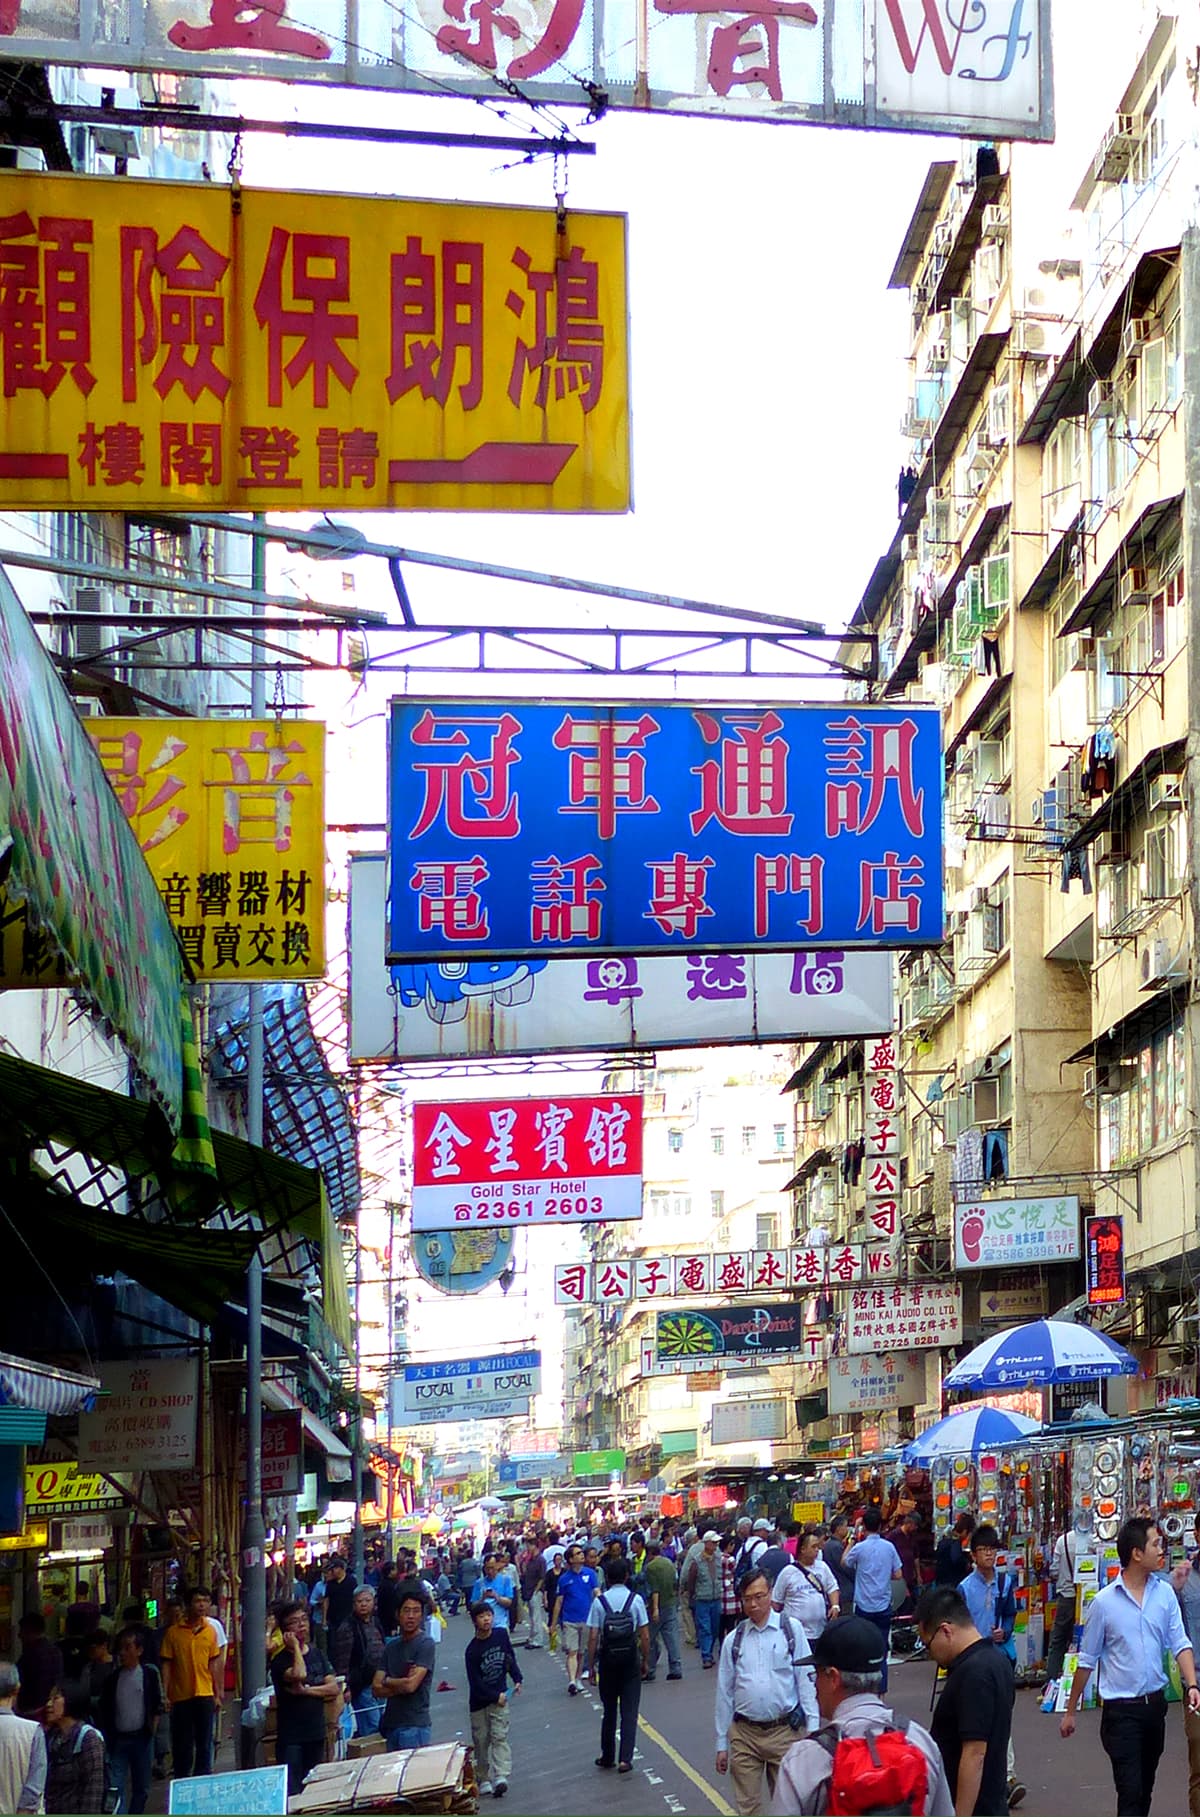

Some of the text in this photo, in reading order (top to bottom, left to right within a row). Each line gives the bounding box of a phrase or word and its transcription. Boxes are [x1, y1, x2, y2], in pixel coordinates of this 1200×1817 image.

[409, 708, 925, 841] 冠軍通訊
[161, 869, 313, 918] 音響器材
[410, 851, 926, 943] 電話專門店
[424, 1102, 632, 1179] 金星賓館
[471, 1180, 587, 1199] Gold Star Hotel
[476, 1196, 604, 1220] 2361 2603
[1056, 1242, 1075, 1254] 1/F
[855, 1312, 876, 1321] MING
[879, 1310, 893, 1320] KAI
[896, 1308, 921, 1319] AUDIO
[160, 1394, 194, 1408] SHOP
